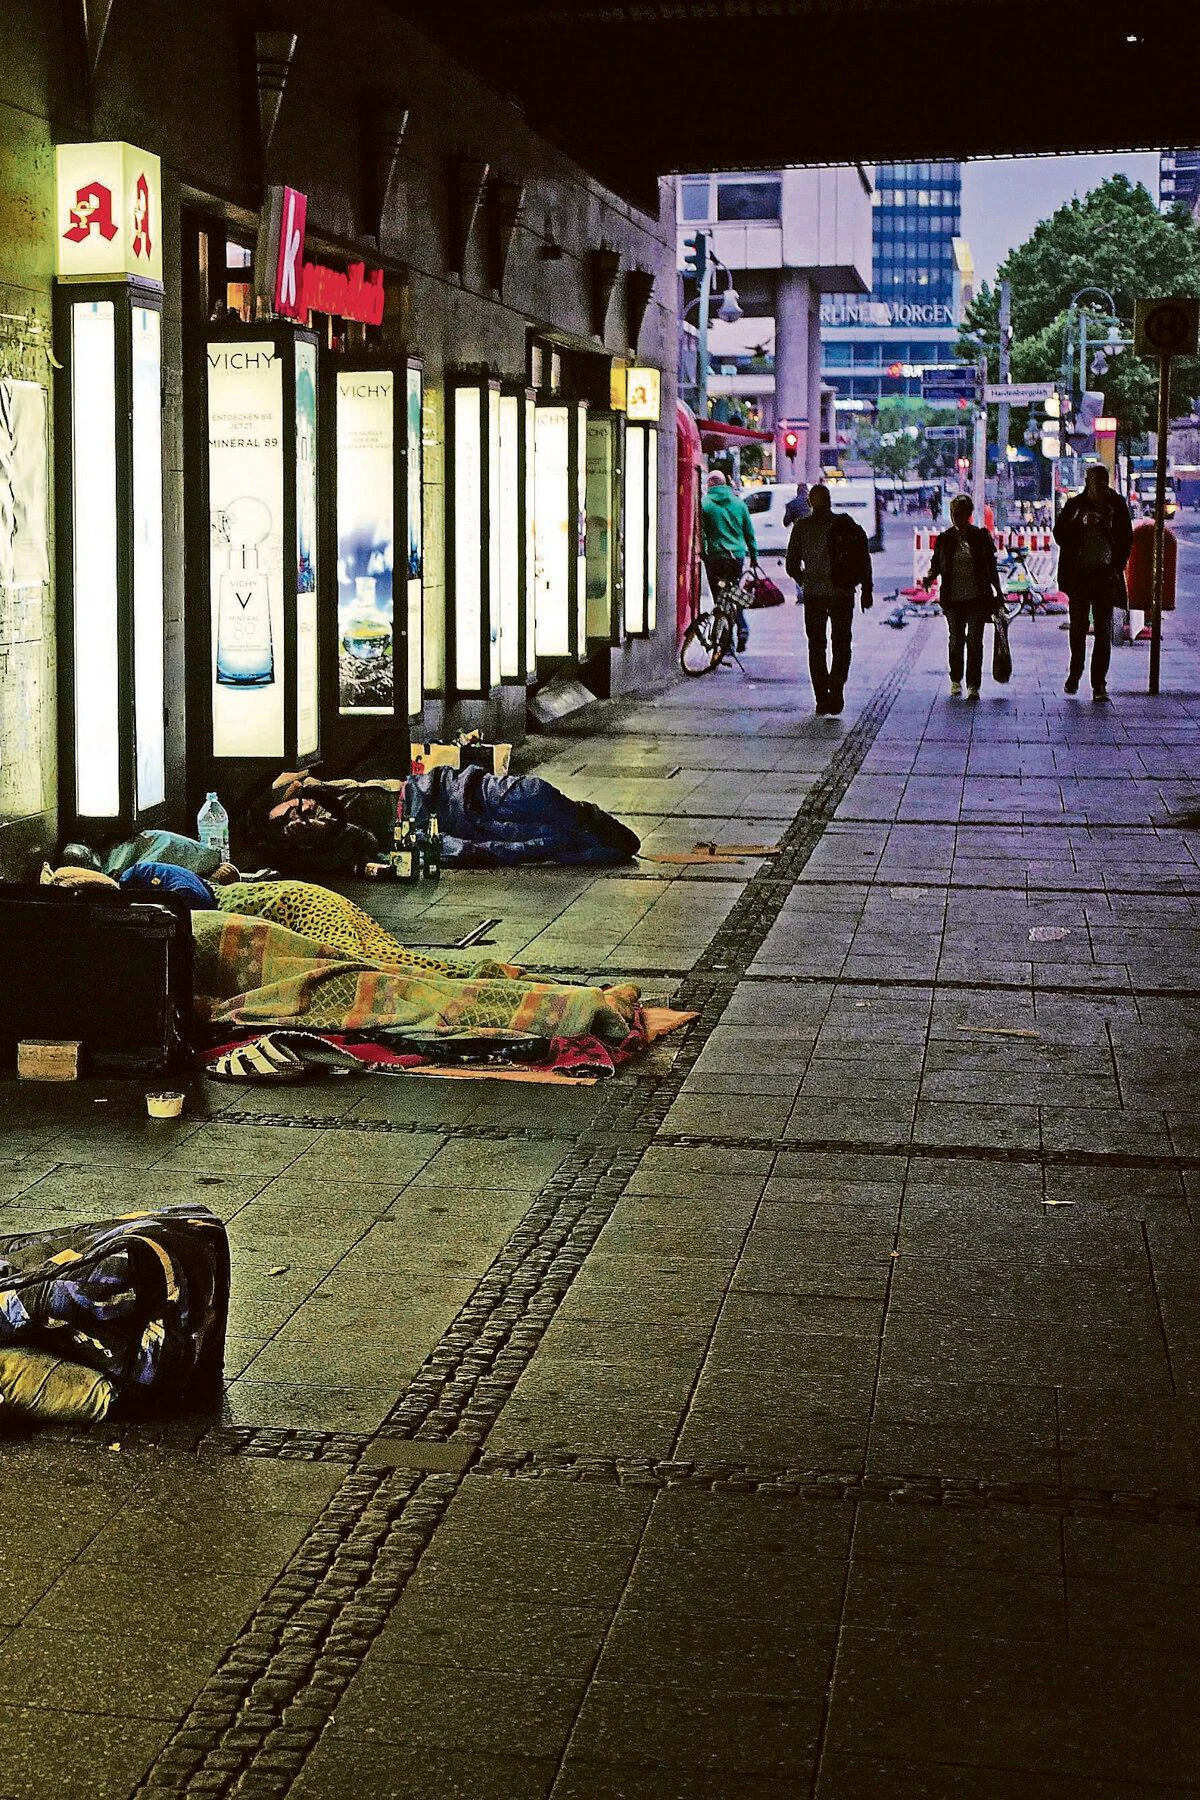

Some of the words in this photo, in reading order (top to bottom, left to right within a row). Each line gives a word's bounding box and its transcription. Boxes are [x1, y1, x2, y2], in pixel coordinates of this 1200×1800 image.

[820, 303, 871, 322] RLINE
[207, 353, 275, 369] VICHY
[340, 385, 390, 398] VICHY
[264, 438, 278, 447] 89
